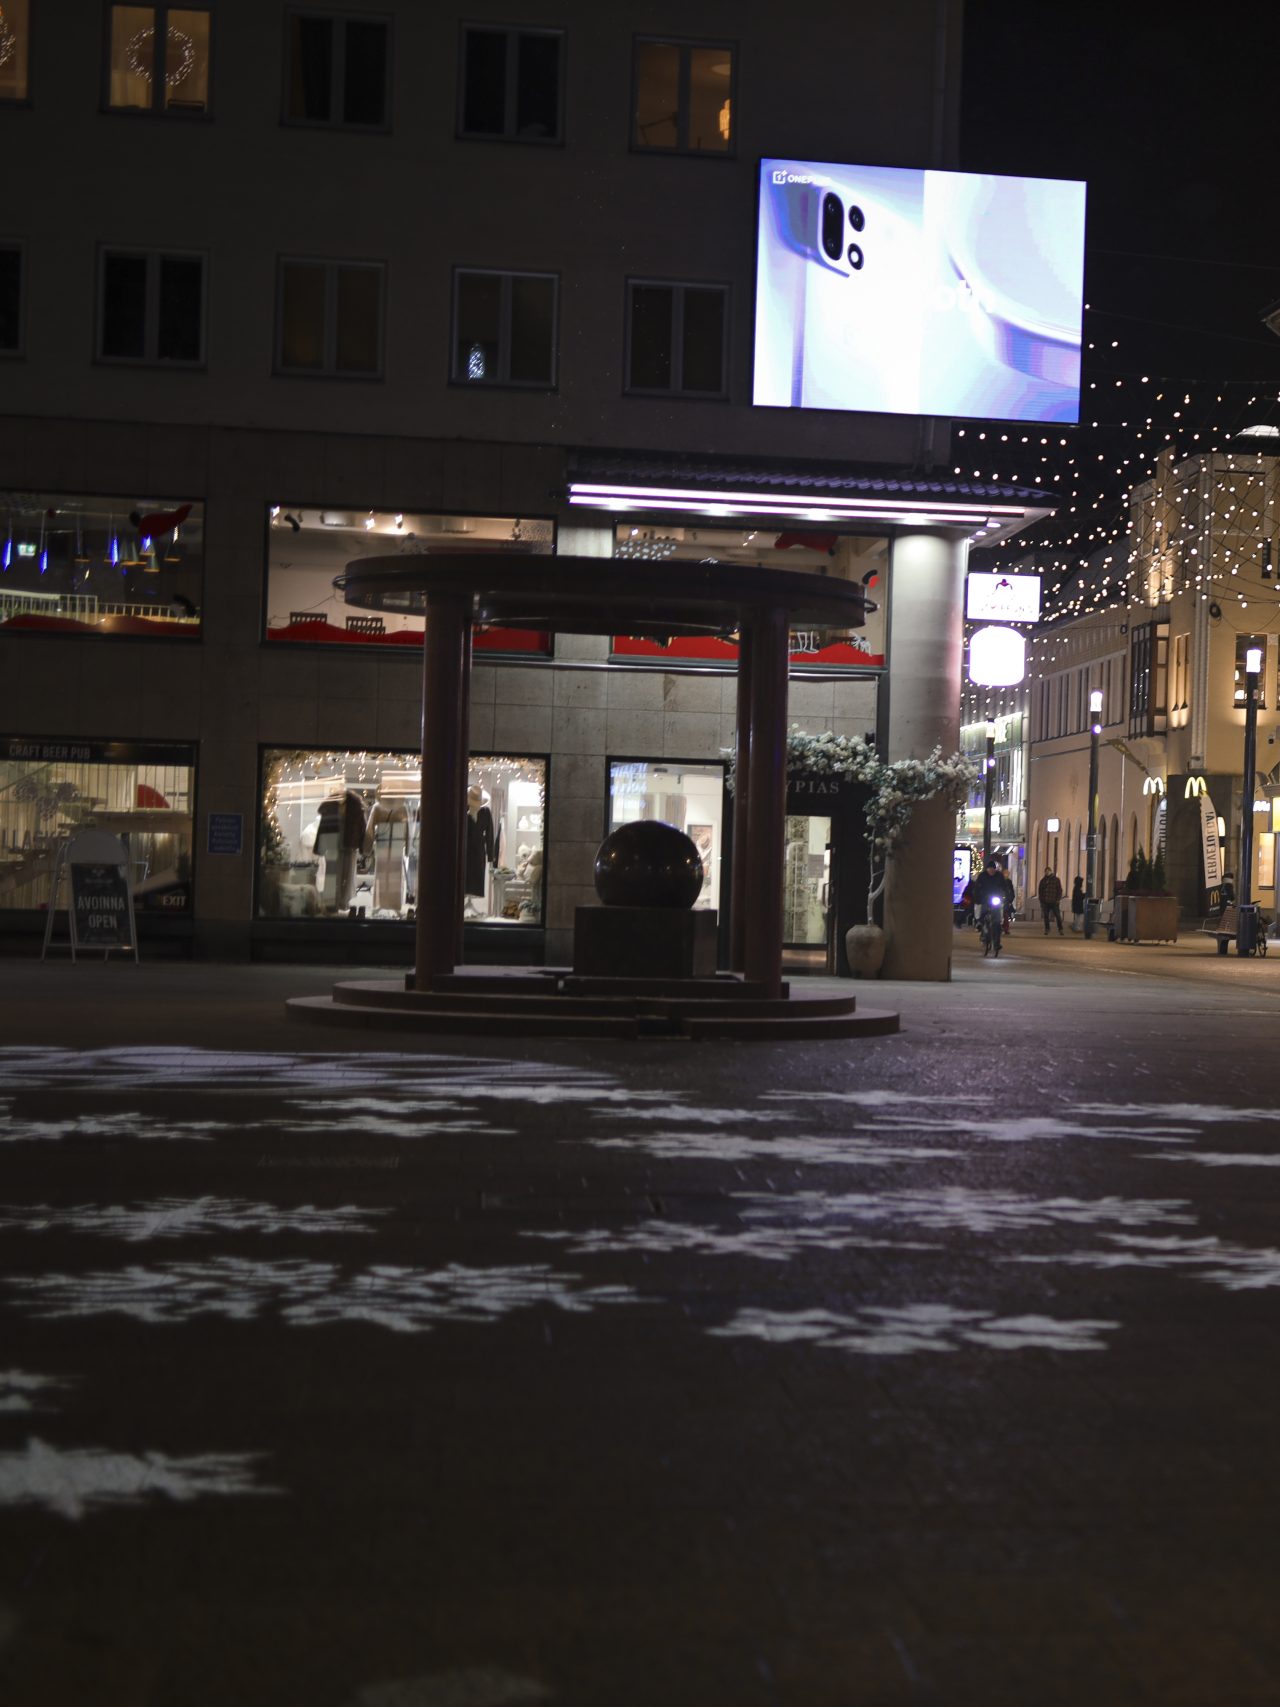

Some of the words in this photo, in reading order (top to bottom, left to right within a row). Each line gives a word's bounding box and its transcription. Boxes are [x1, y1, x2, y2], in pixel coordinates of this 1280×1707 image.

[9, 744, 40, 758] CRAFT
[43, 746, 68, 759] BEER
[71, 747, 90, 759] PUB
[78, 896, 125, 910] AVOINNA
[162, 895, 186, 906] EXIT
[88, 914, 118, 928] OPEN
